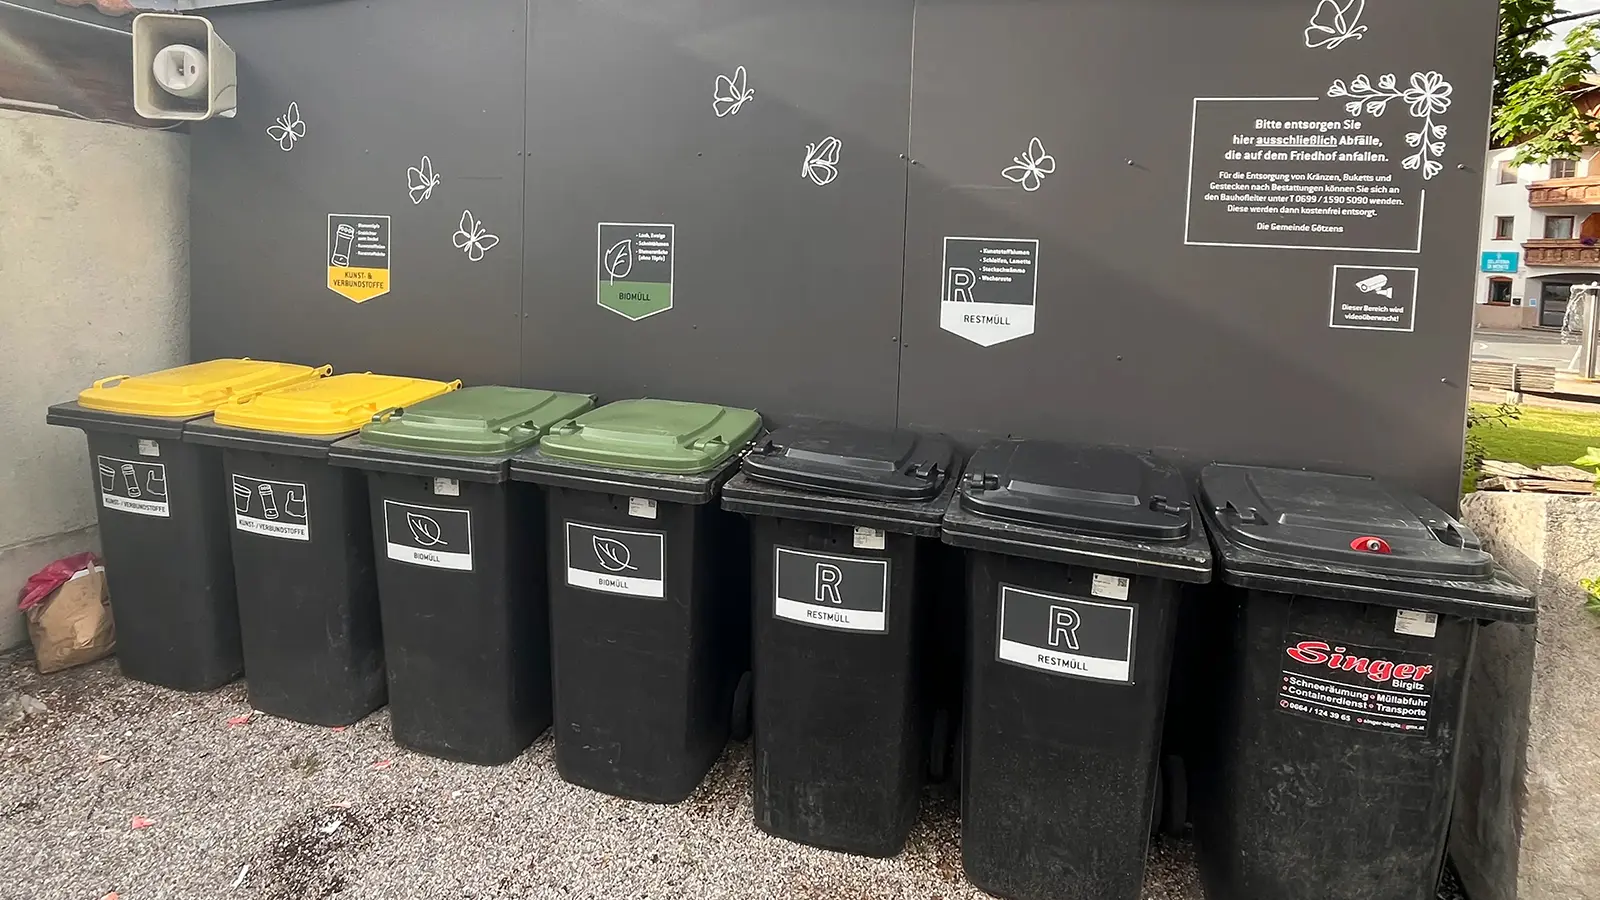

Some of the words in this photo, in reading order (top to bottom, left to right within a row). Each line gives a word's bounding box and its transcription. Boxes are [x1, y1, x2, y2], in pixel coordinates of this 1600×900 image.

[1255, 120, 1282, 130] Bitte
[1284, 121, 1341, 132] entsorgen
[1344, 121, 1361, 130] Sie
[1233, 135, 1254, 144] hier
[1256, 136, 1337, 147] ausschließlich
[1339, 136, 1383, 147] Abfälle,
[1225, 150, 1242, 160] die
[1244, 150, 1263, 160] auf
[1264, 151, 1287, 161] dem
[1290, 151, 1338, 161] Friedhof
[1339, 152, 1389, 162] anfallen.
[1219, 171, 1232, 179] Für
[1247, 172, 1289, 182] Entsorgung
[1307, 173, 1341, 182] Kränzen,
[1376, 174, 1391, 182] und
[1210, 183, 1249, 191] Gestecken
[1272, 184, 1324, 194] Bestattungen
[1325, 185, 1355, 193] können
[1205, 193, 1219, 201] den
[1221, 194, 1266, 202] Bauhofleiter
[1324, 196, 1344, 204] 1590
[1250, 206, 1278, 214] werden
[1280, 206, 1300, 214] dann
[1301, 207, 1340, 215] kostenfrei
[1342, 208, 1377, 218] entsorgt.
[1257, 223, 1269, 231] Die
[1271, 223, 1309, 232] Gemeinde
[1311, 224, 1343, 232] Götzens
[333, 280, 384, 289] VERBUNDSTOFFE
[619, 292, 651, 301] BIOMÜLL
[964, 314, 1011, 325] RESTMÜLL
[414, 552, 440, 563] BIOMÜLL
[599, 578, 628, 589] BIOMÜLL
[815, 562, 844, 604] R
[807, 609, 850, 624] RESTMÜLL
[1048, 605, 1081, 650] R
[1037, 654, 1088, 671] RESTMÜLL
[1286, 641, 1433, 682] Singer
[1392, 679, 1425, 691] Birgitz
[1289, 677, 1369, 701] Schneeräumung
[1377, 694, 1428, 707] Müllabfuhr
[1288, 686, 1368, 709] Containerdienst
[1377, 703, 1427, 717] Transporte
[1289, 703, 1308, 712] 0664
[1315, 708, 1328, 717] 124
[1330, 711, 1339, 719] 39
[1341, 713, 1351, 722] 65
